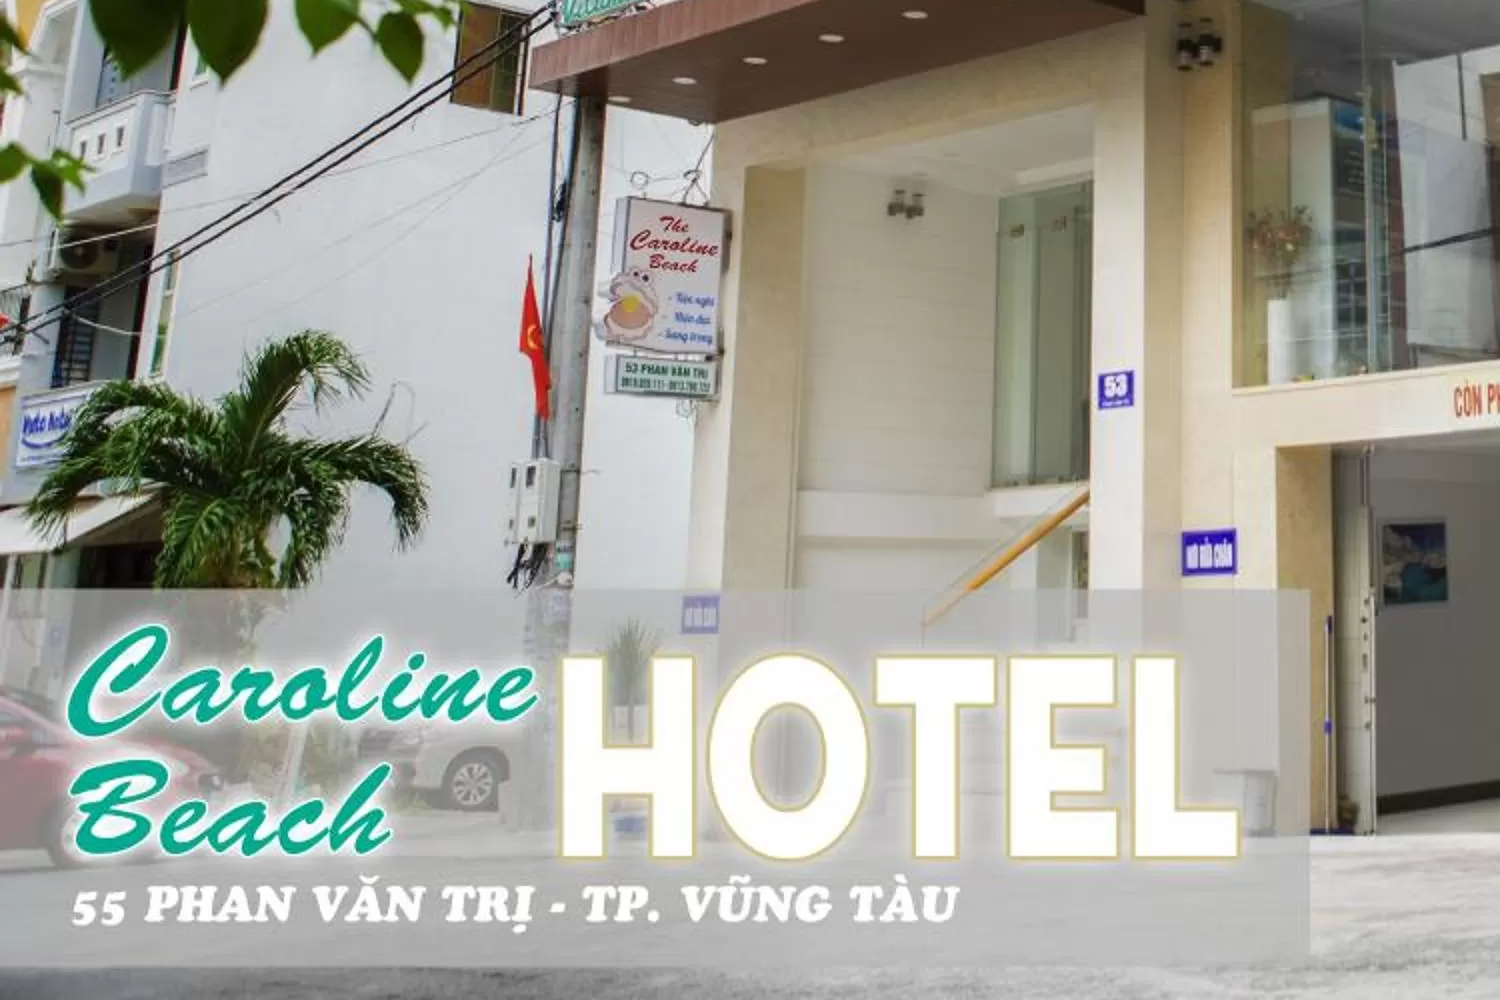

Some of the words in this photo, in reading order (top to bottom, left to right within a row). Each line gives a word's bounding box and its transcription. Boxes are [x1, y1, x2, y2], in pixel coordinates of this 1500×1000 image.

[659, 215, 689, 233] The
[630, 229, 719, 257] Caroline
[649, 253, 699, 273] Beach
[1104, 373, 1128, 398] 53
[1454, 380, 1482, 418] CÒN
